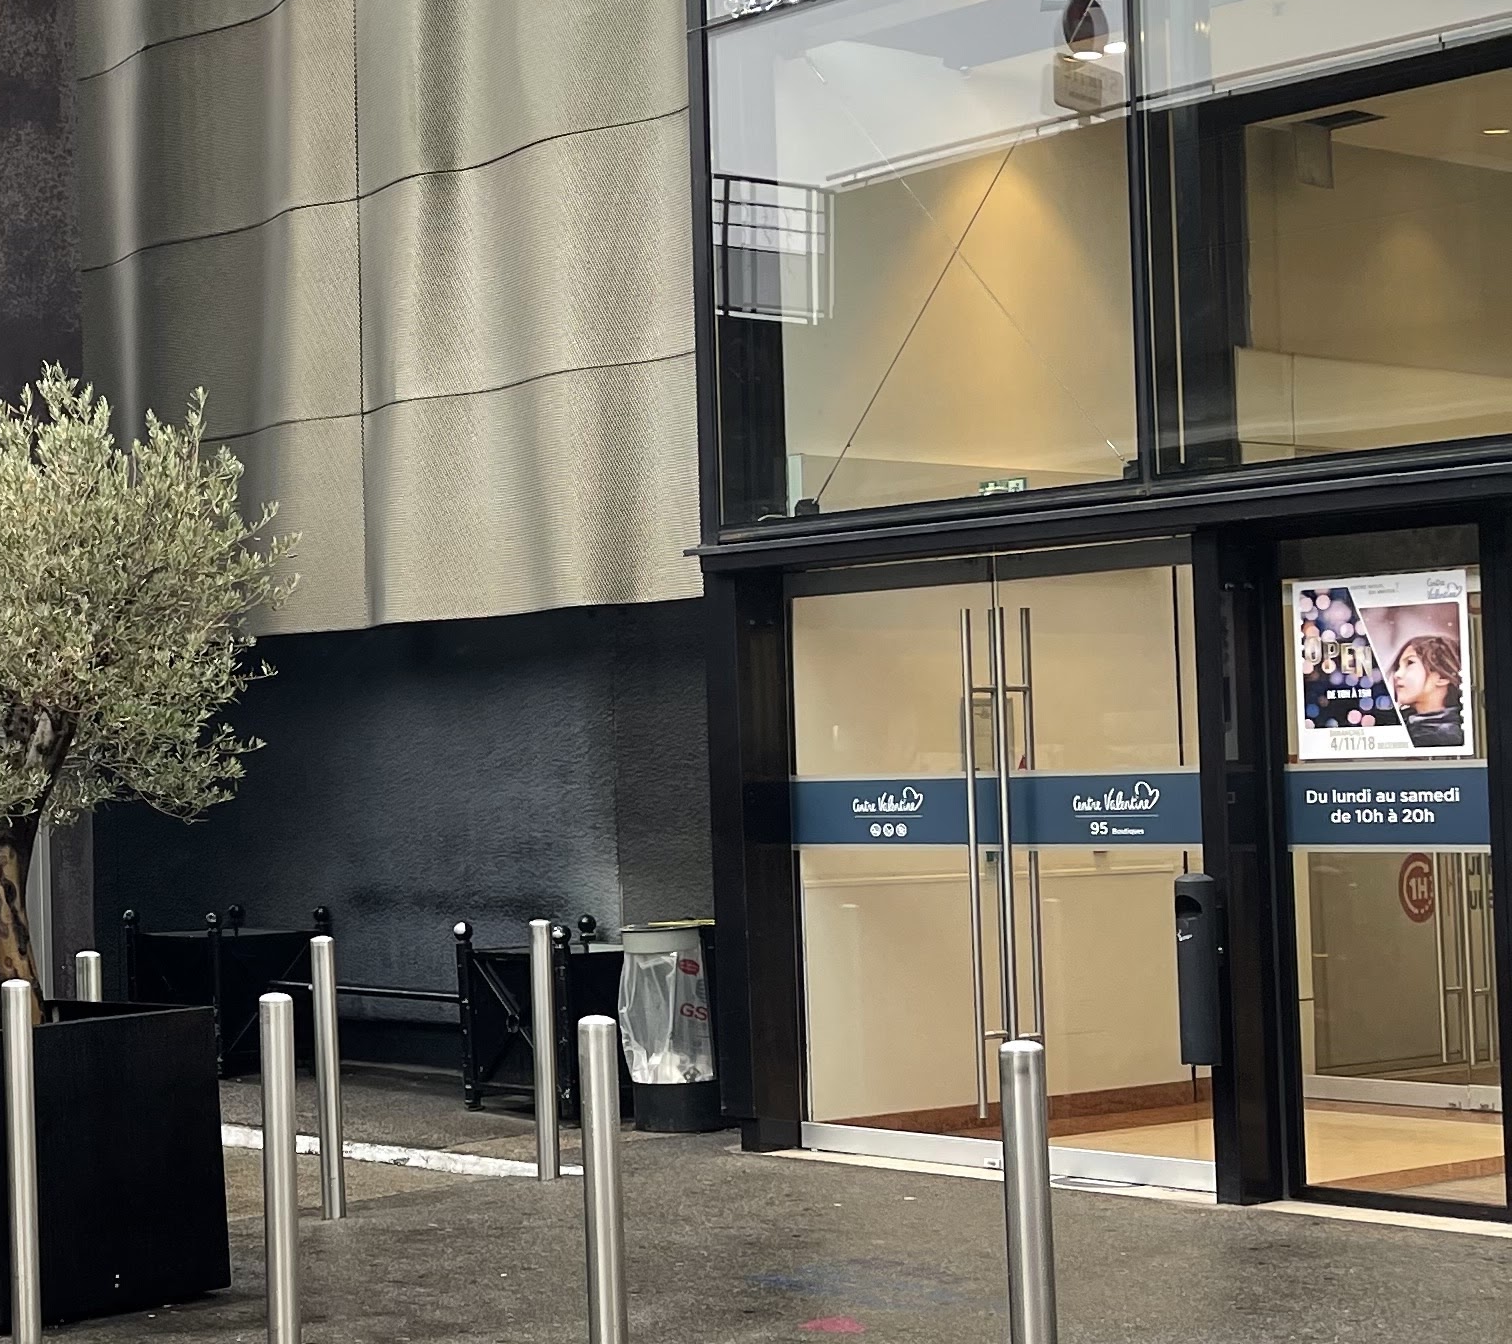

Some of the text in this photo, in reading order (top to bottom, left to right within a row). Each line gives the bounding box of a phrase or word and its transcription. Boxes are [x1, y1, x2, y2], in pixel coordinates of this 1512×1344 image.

[1304, 637, 1373, 677] OPEN
[1330, 736, 1376, 751] 4/11/18
[1073, 784, 1157, 811] Centre Valentine
[1306, 788, 1460, 804] Du lundi au samedi
[1331, 809, 1435, 823] de 10h à 20h
[1090, 821, 1108, 835] 95
